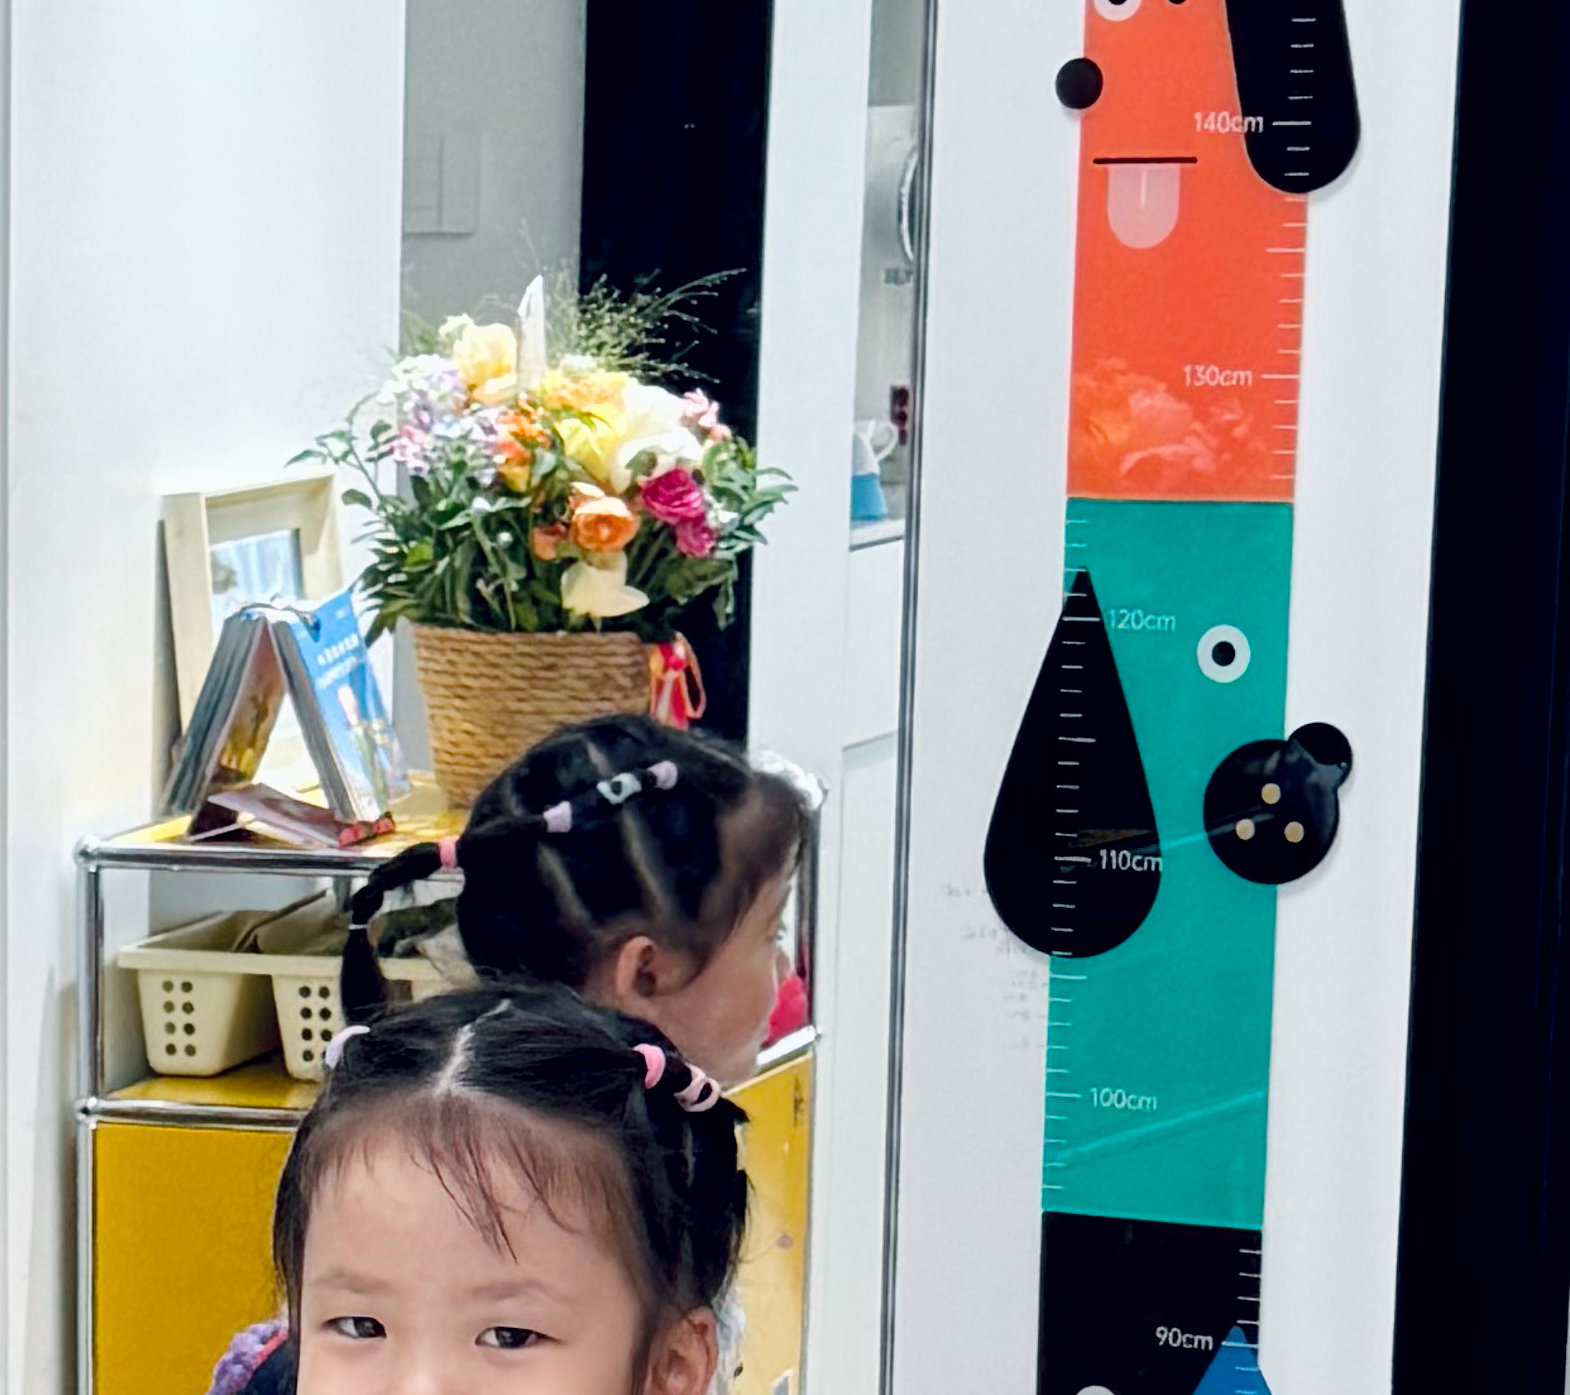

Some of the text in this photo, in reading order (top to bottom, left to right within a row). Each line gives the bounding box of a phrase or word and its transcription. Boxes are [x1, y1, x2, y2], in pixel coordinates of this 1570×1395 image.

[1193, 111, 1264, 135] 140cm
[1183, 364, 1254, 389] 130cm
[1108, 608, 1177, 633] 120cm
[1098, 850, 1164, 875] 110cm
[1089, 1086, 1158, 1114] 100cm
[1155, 1325, 1214, 1351] 90cm
